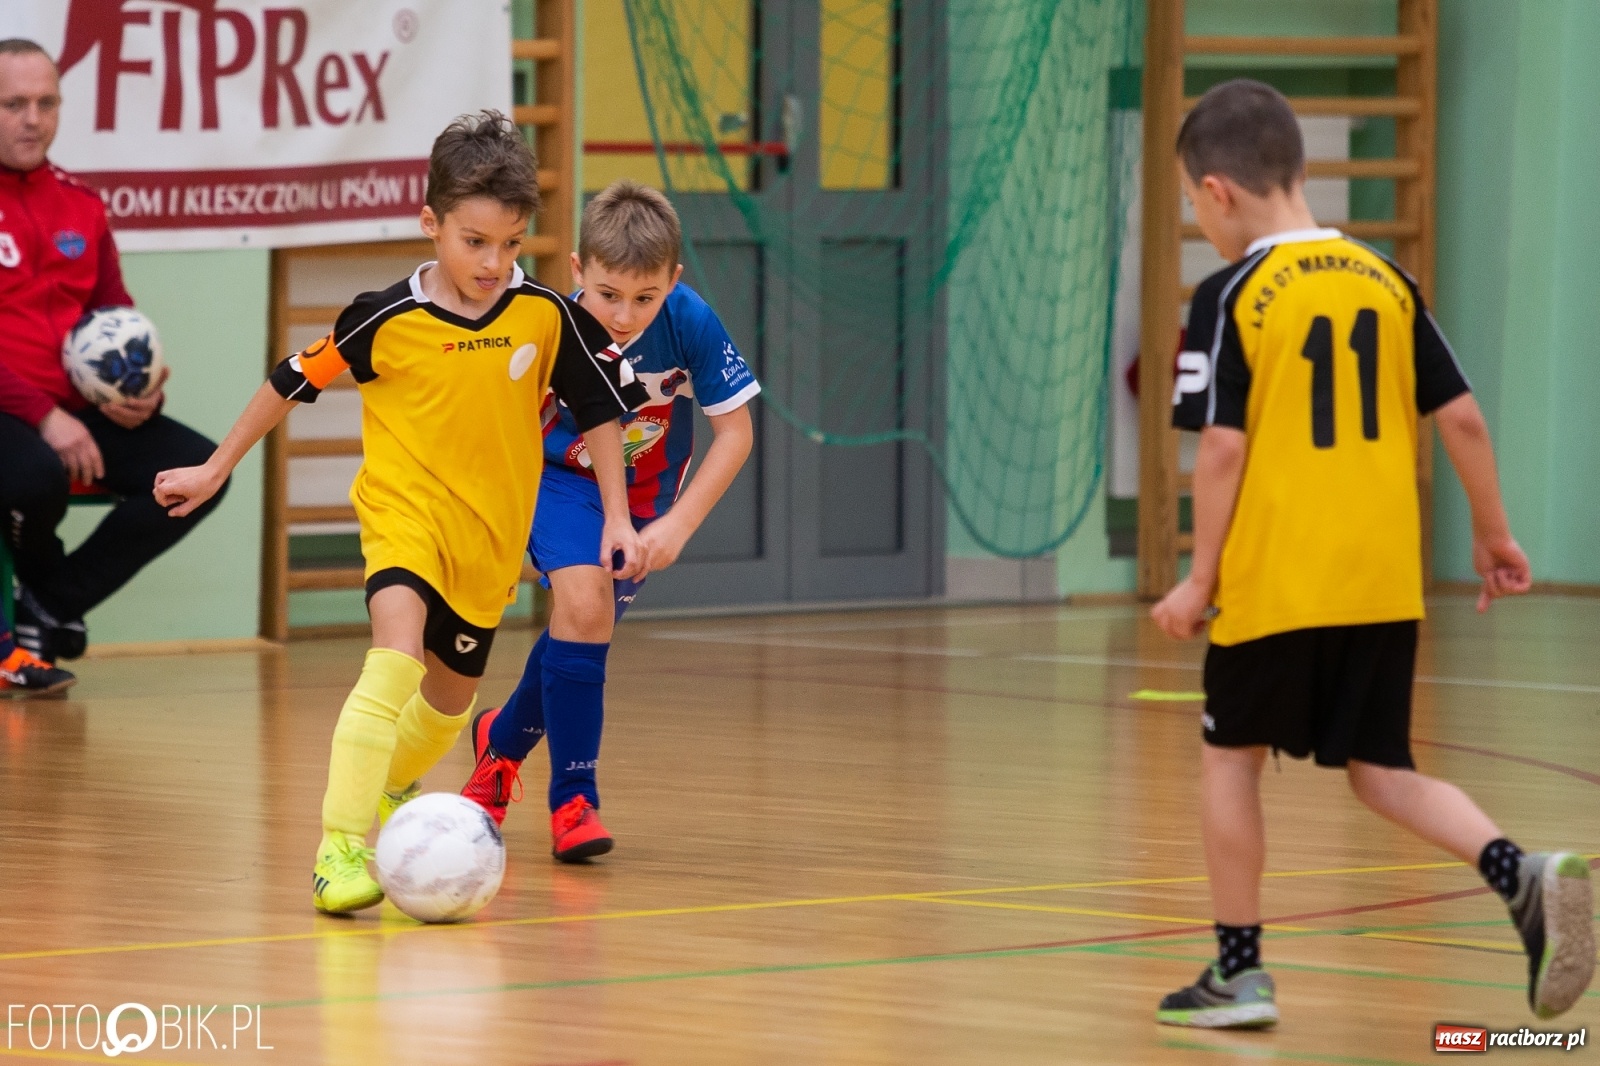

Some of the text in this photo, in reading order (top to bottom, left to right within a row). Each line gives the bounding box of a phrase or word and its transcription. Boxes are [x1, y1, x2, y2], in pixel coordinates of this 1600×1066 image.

[168, 186, 177, 217] I
[321, 179, 338, 209] U
[341, 167, 404, 208] PSÓW
[458, 336, 512, 352] PATRICK
[1301, 308, 1380, 448] 11
